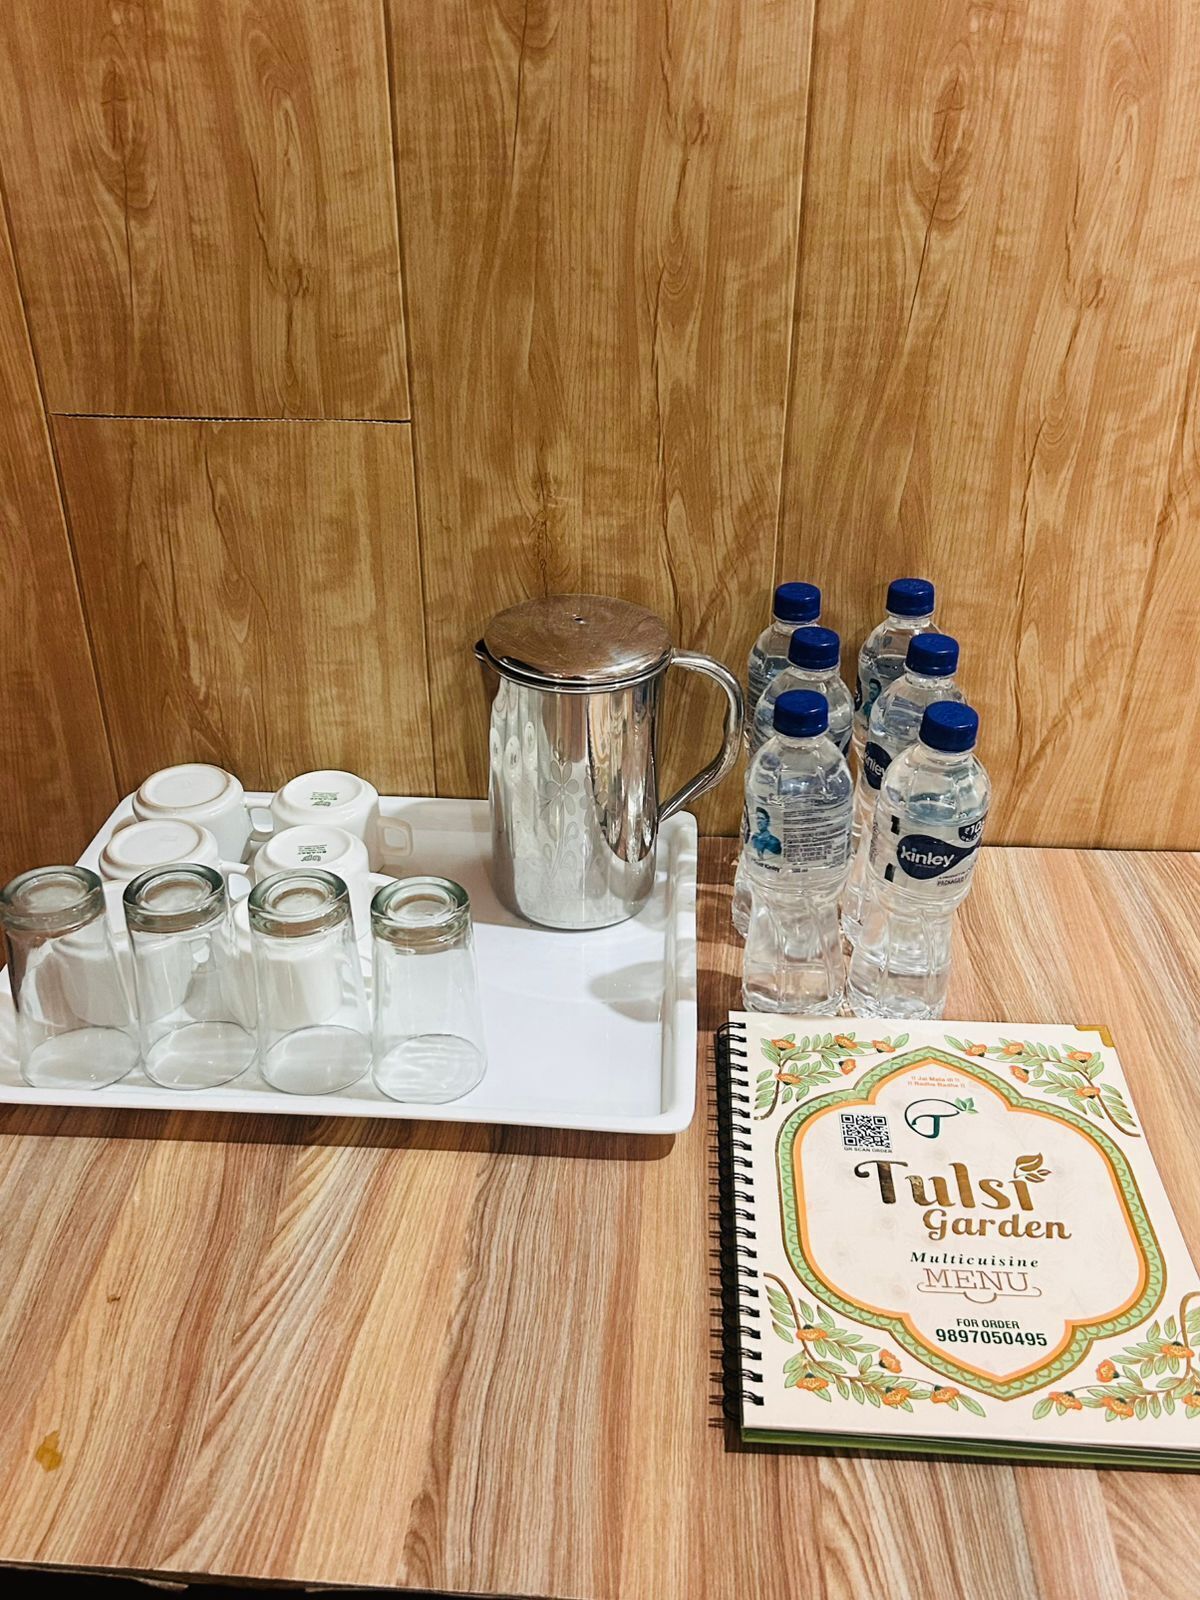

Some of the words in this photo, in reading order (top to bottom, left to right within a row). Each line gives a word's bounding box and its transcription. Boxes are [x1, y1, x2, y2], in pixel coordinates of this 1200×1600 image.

[900, 845, 955, 867] kinley
[854, 1156, 1040, 1211] Tulsi
[922, 1208, 1072, 1241] Garden
[910, 1251, 1040, 1268] Multicuisine
[922, 1268, 1029, 1292] MENU
[956, 1318, 979, 1328] FOR
[982, 1319, 1020, 1330] ORDER
[936, 1328, 1048, 1346] 9897050495
